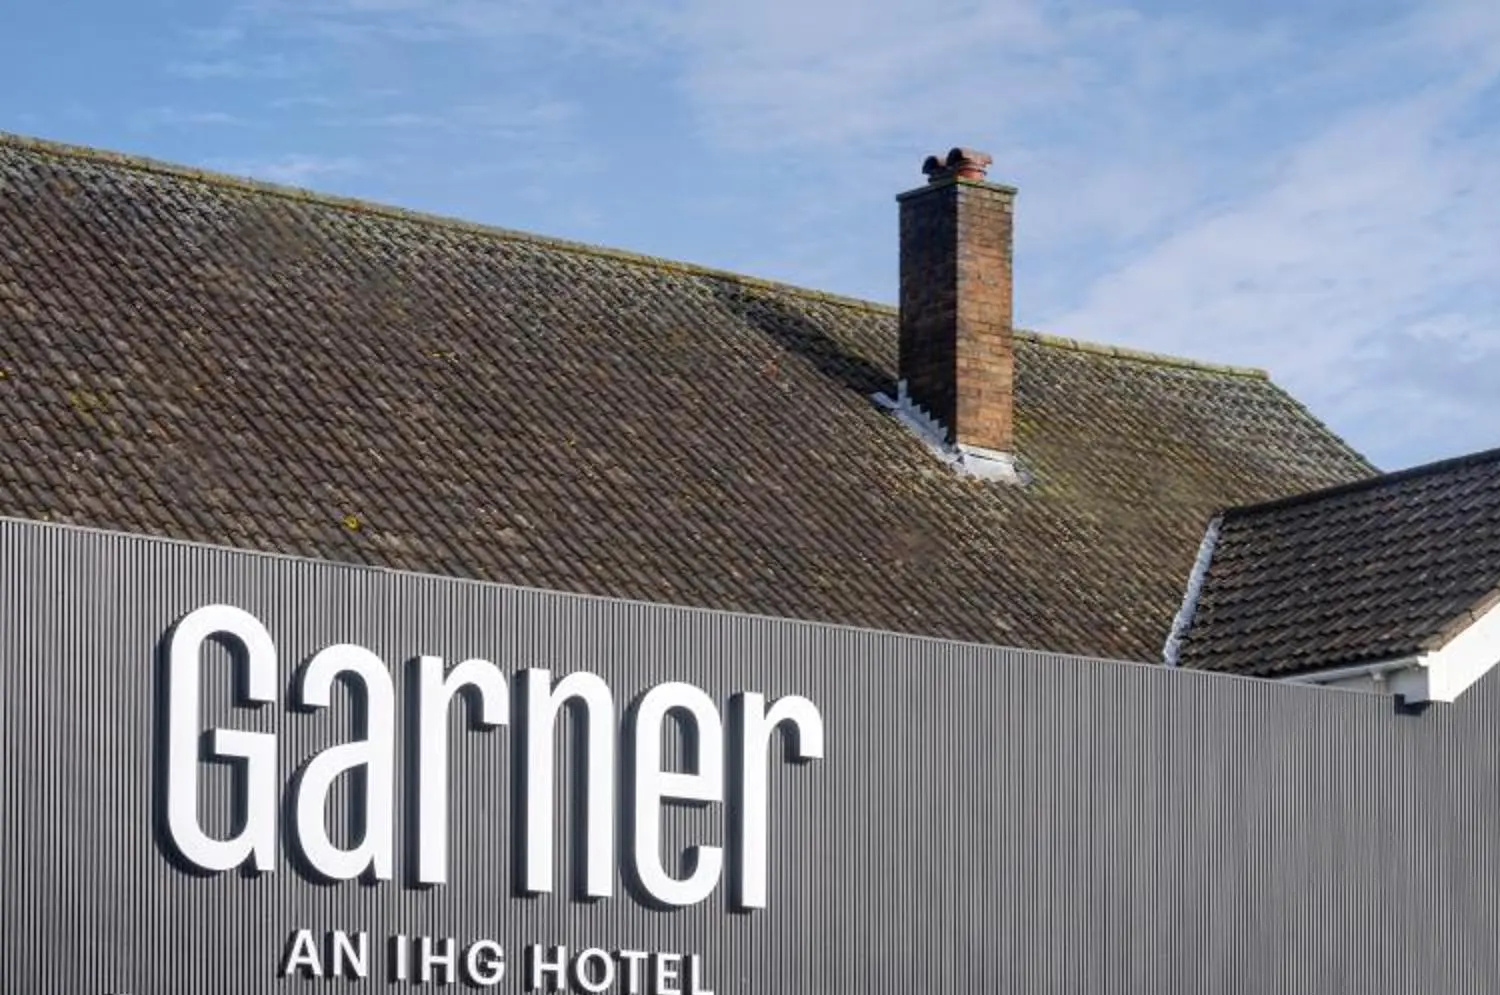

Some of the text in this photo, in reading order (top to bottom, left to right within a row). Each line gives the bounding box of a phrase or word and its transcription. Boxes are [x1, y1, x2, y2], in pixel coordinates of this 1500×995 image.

[165, 603, 824, 909] Garner
[285, 929, 367, 978] AN
[396, 935, 506, 986] IHG
